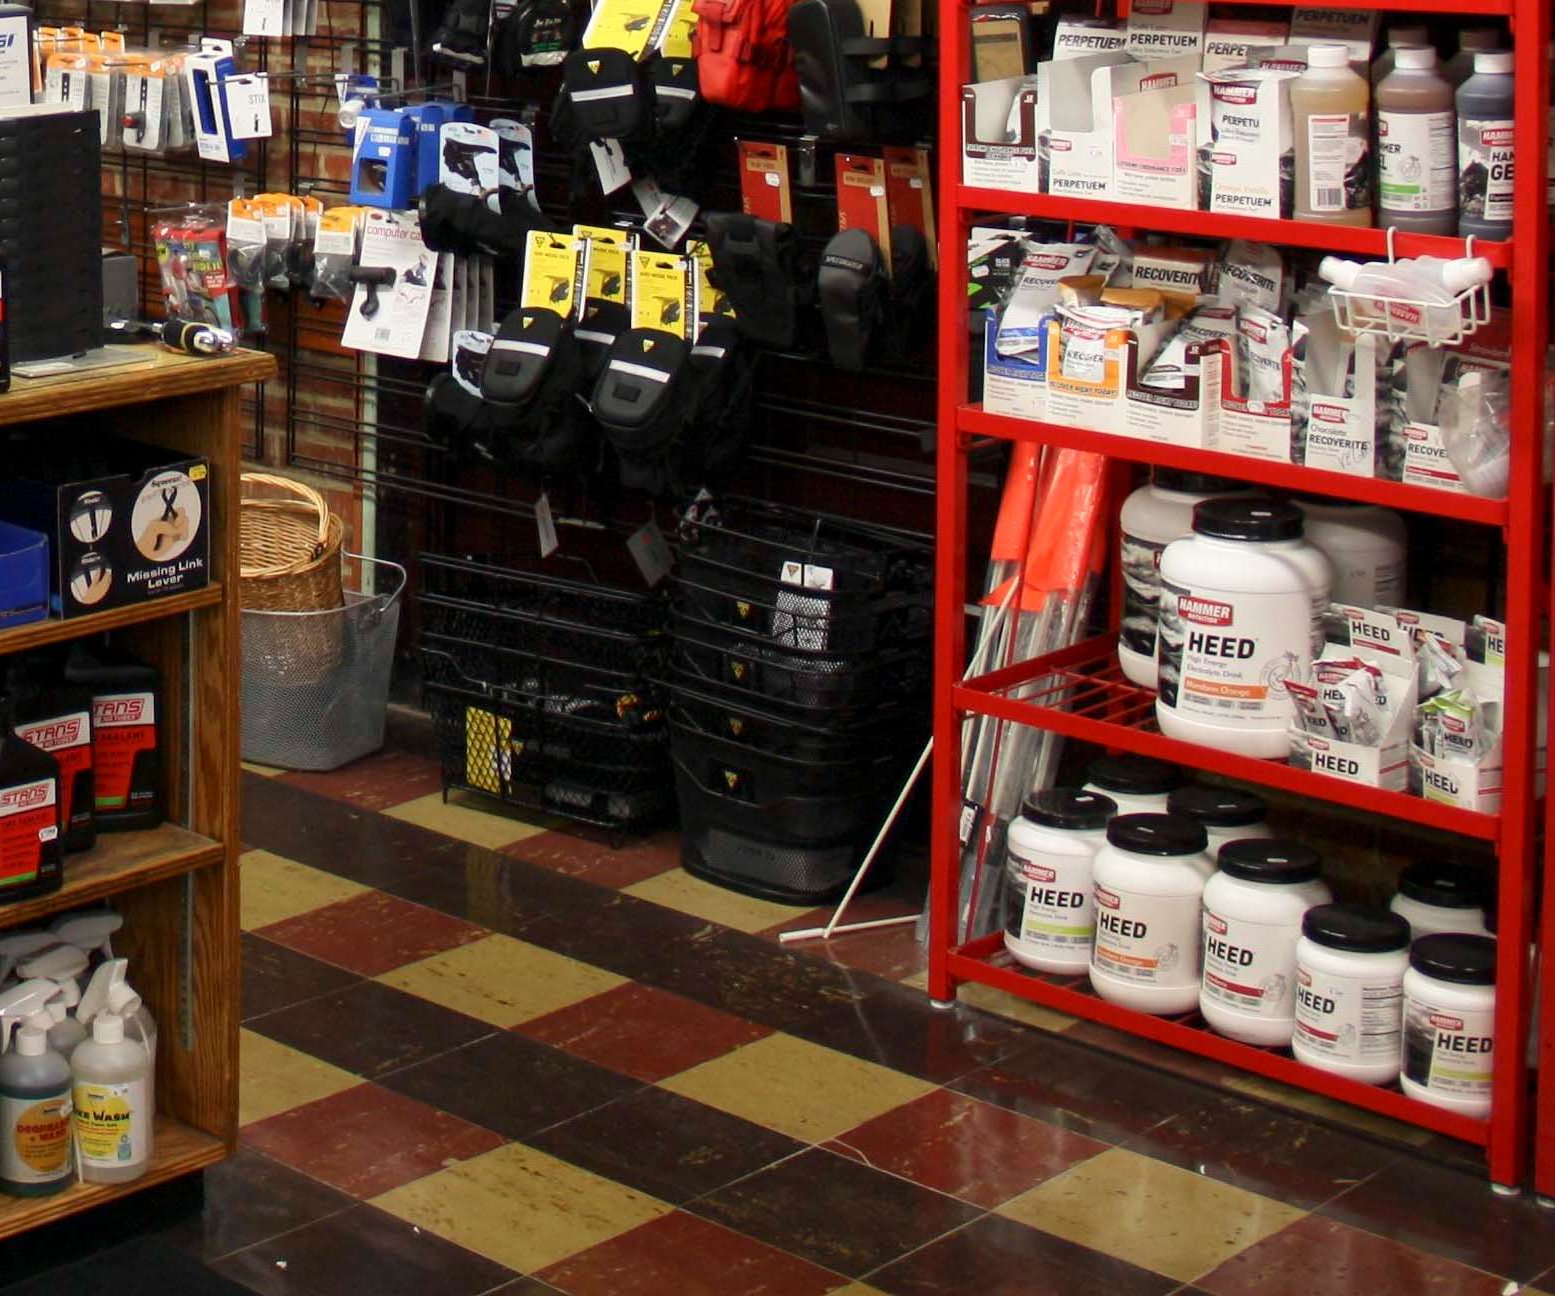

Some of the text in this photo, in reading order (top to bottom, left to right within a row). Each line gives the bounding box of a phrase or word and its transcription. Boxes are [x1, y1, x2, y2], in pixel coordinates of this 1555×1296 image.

[1058, 34, 1126, 50] PERPETUEM
[1130, 33, 1198, 48] PERPETUEM
[1207, 41, 1246, 56] PERPE
[248, 94, 266, 105] STIX
[1213, 85, 1257, 99] HAMMER
[1052, 178, 1106, 191] PERPETUEM
[1215, 193, 1271, 207] PERPETUEM
[367, 225, 408, 241] computer
[1027, 254, 1068, 266] HAMMER
[1309, 434, 1368, 451] RECOVERITE
[1408, 443, 1445, 457] RECOVE
[127, 557, 204, 584] Missing Link
[147, 572, 184, 590] Lever
[1180, 598, 1231, 618] HAMMER
[1352, 621, 1390, 642] HEED
[1189, 631, 1256, 659] HEED
[1488, 635, 1504, 653] HE
[1315, 752, 1359, 775] HEED
[1023, 864, 1054, 880] HAMMER
[1030, 886, 1084, 909] HEED
[1099, 912, 1147, 939] HEED
[1207, 939, 1254, 967] HEED
[1297, 987, 1335, 1014] HEED
[1437, 1032, 1493, 1054] HEED
